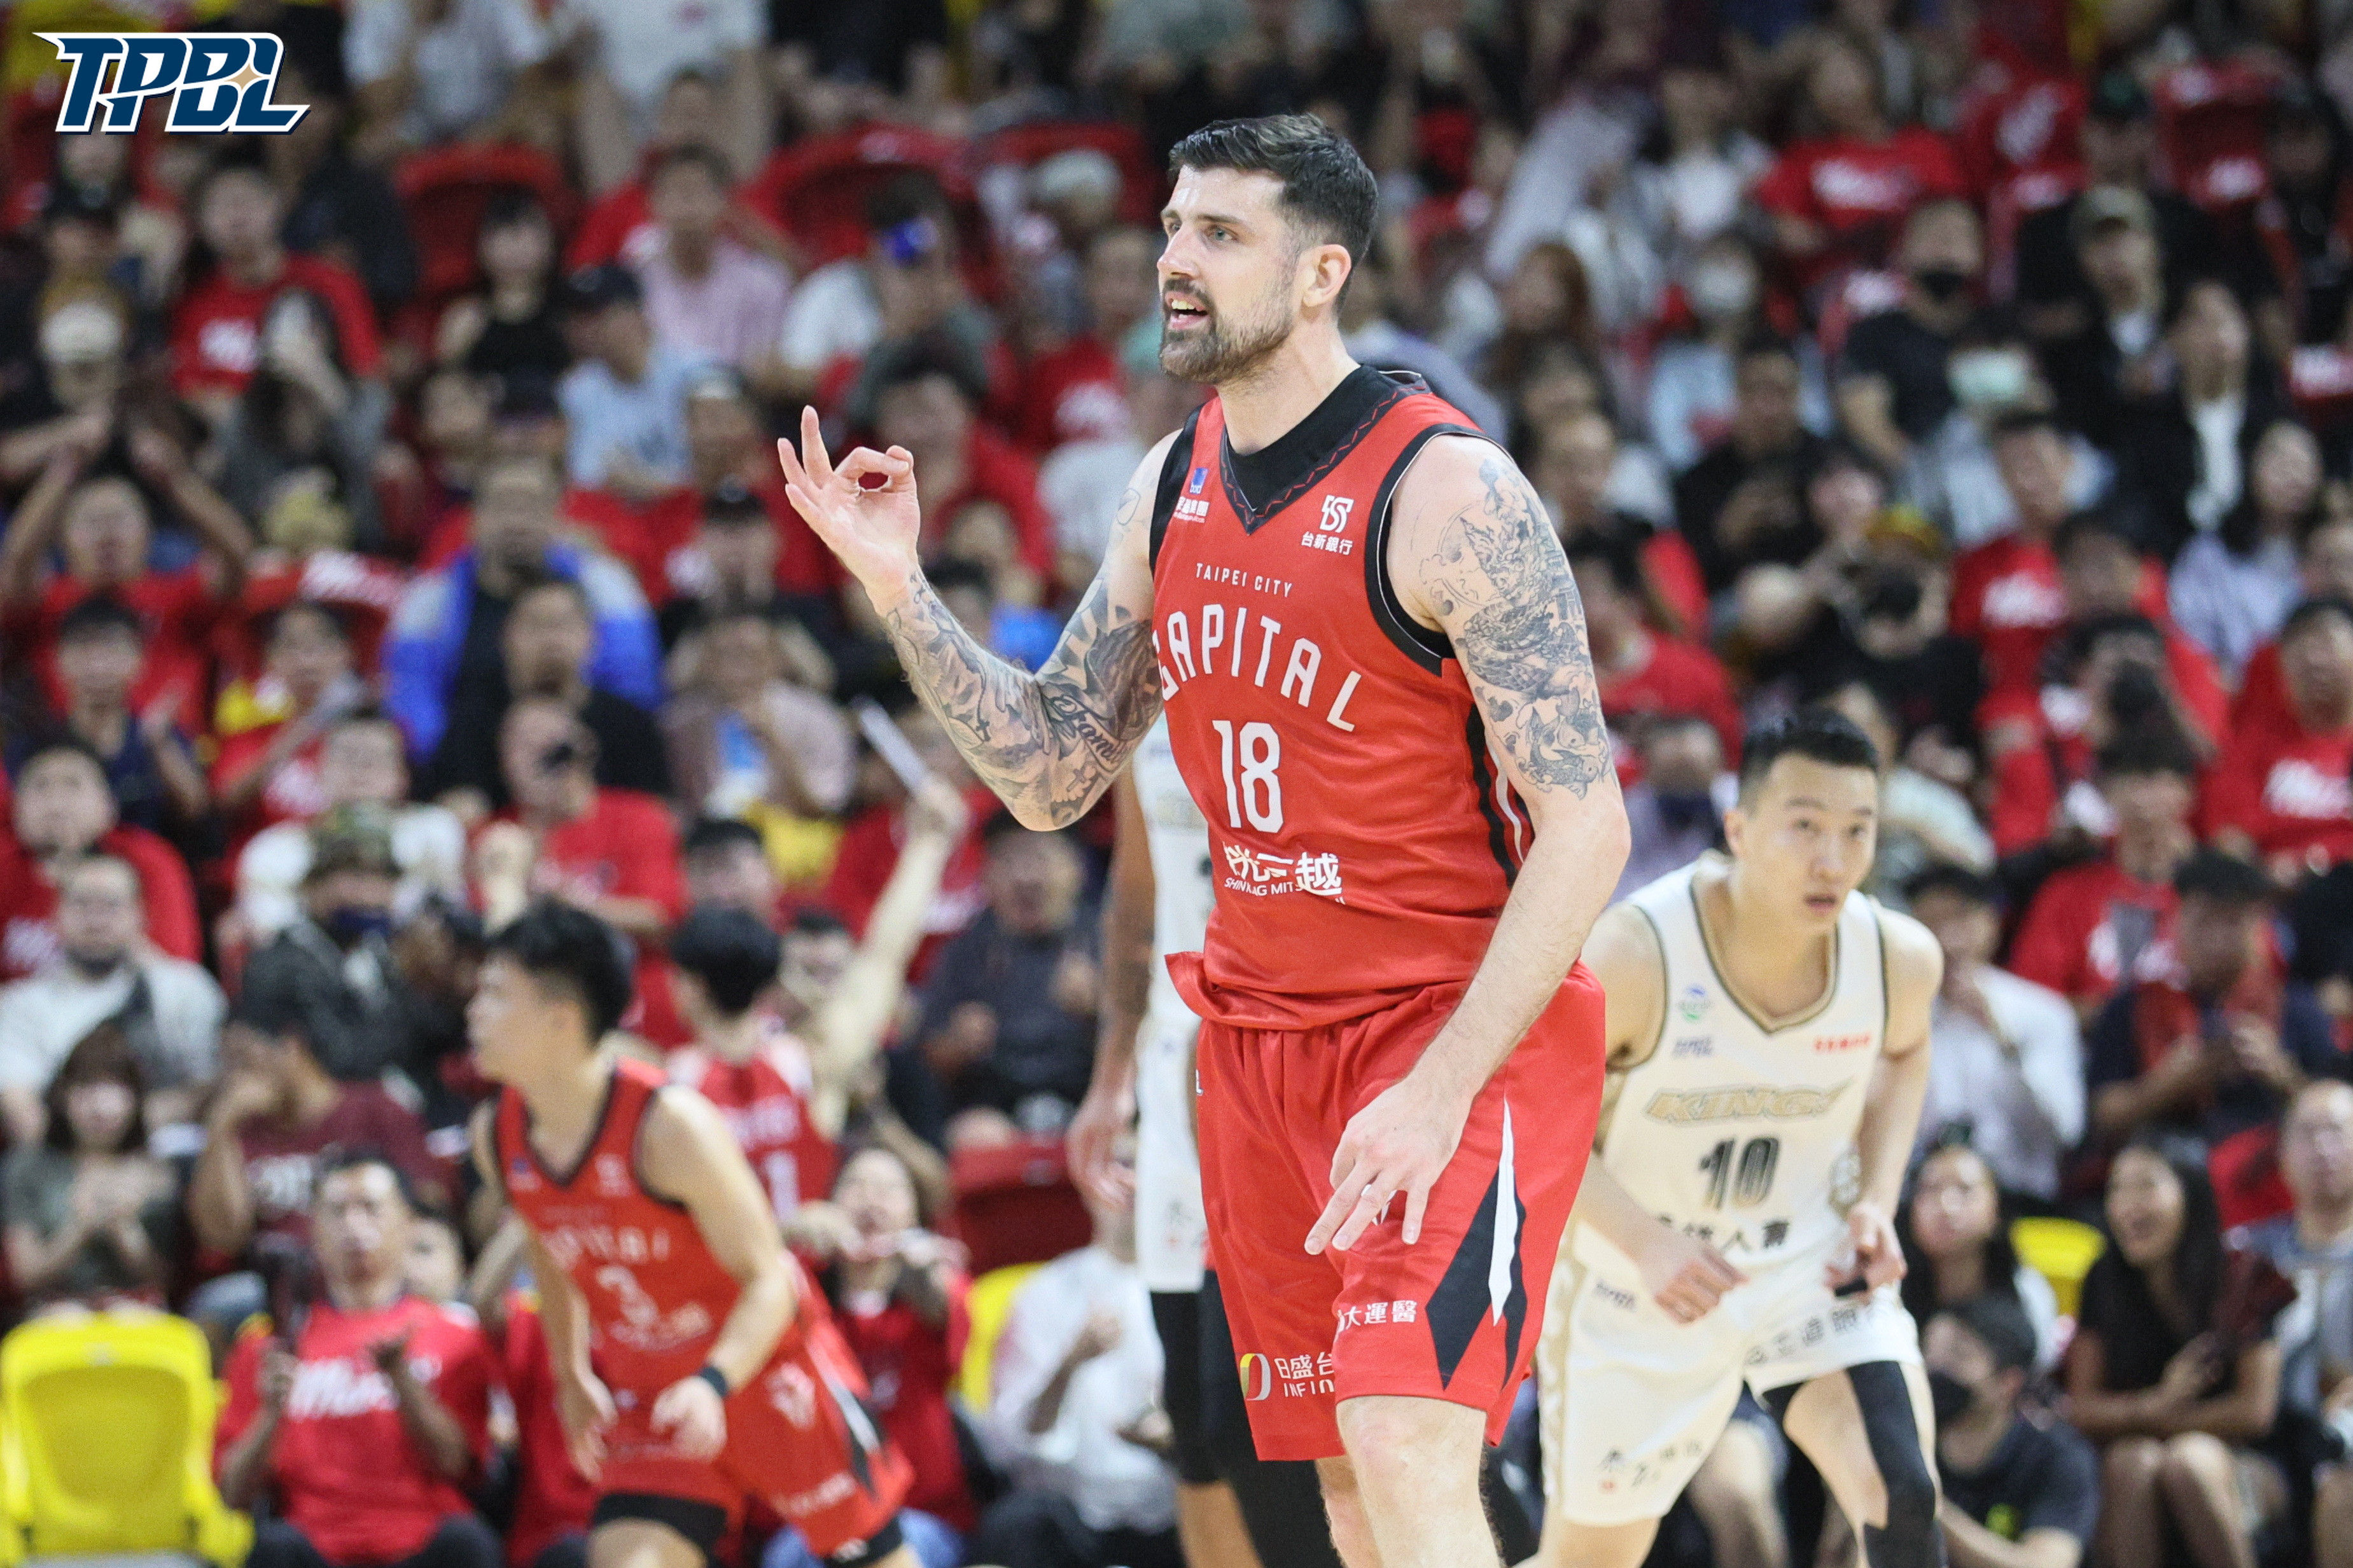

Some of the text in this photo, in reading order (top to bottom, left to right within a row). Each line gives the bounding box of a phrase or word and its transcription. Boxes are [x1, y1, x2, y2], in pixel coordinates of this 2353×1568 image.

[1196, 563, 1293, 597] TAIPEI CITY
[1301, 531, 1353, 555] 台新銀行
[1152, 604, 1362, 732] CAPITAL
[1211, 719, 1284, 833] 18
[1699, 1135, 1781, 1211] 10
